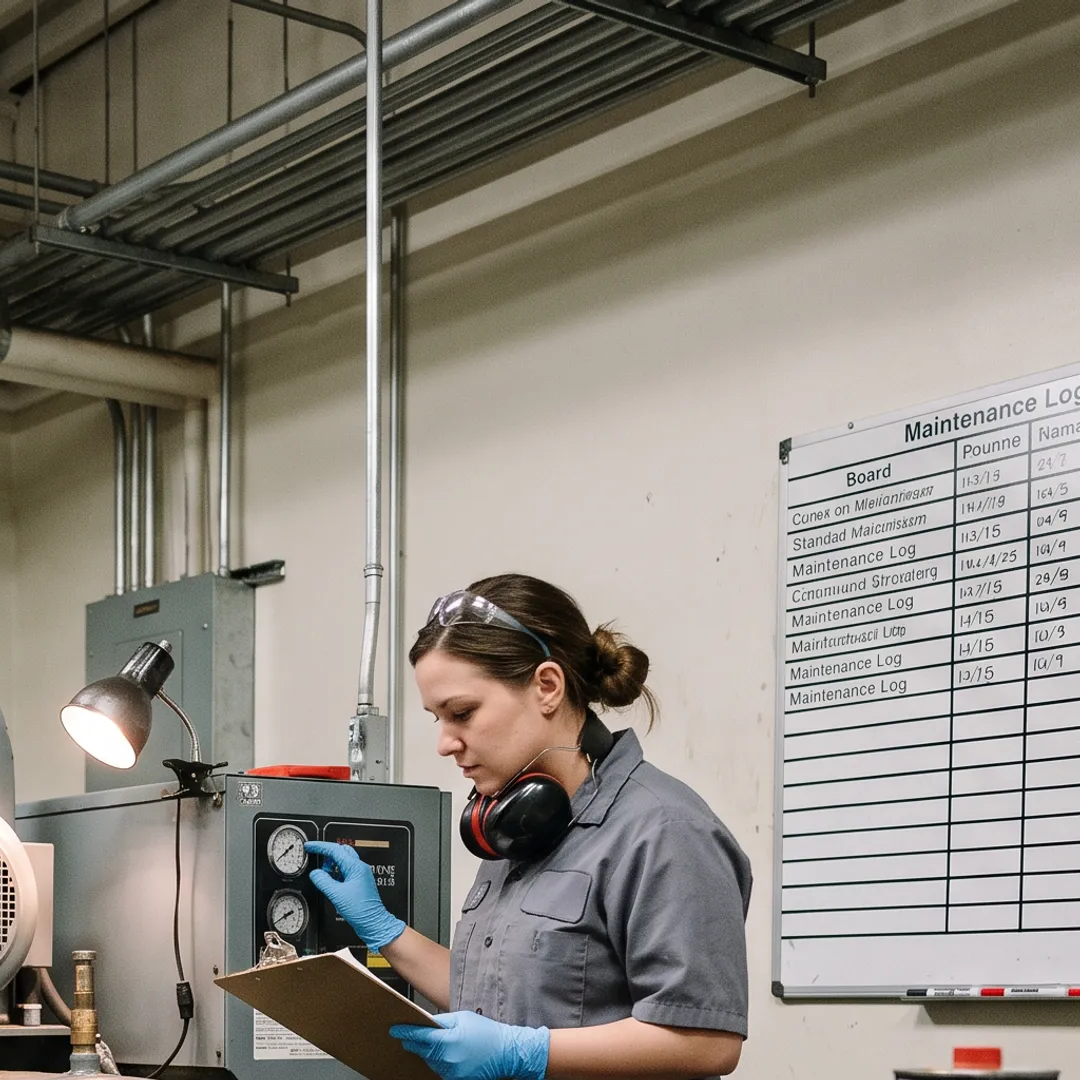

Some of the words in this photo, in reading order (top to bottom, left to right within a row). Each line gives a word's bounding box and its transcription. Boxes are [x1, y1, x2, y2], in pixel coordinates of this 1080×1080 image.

[905, 397, 1037, 442] Maintenance
[1045, 384, 1080, 408] Log
[963, 435, 1021, 459] Pounne
[846, 463, 892, 487] Board
[834, 504, 850, 517] on
[793, 529, 846, 551] Standad
[792, 550, 884, 577] Maintenance
[890, 543, 916, 559] Log
[888, 596, 914, 611] Log
[790, 658, 872, 681] Maintenance
[877, 653, 902, 668] Log
[789, 683, 876, 706] Maintenance
[881, 679, 907, 693] Log
